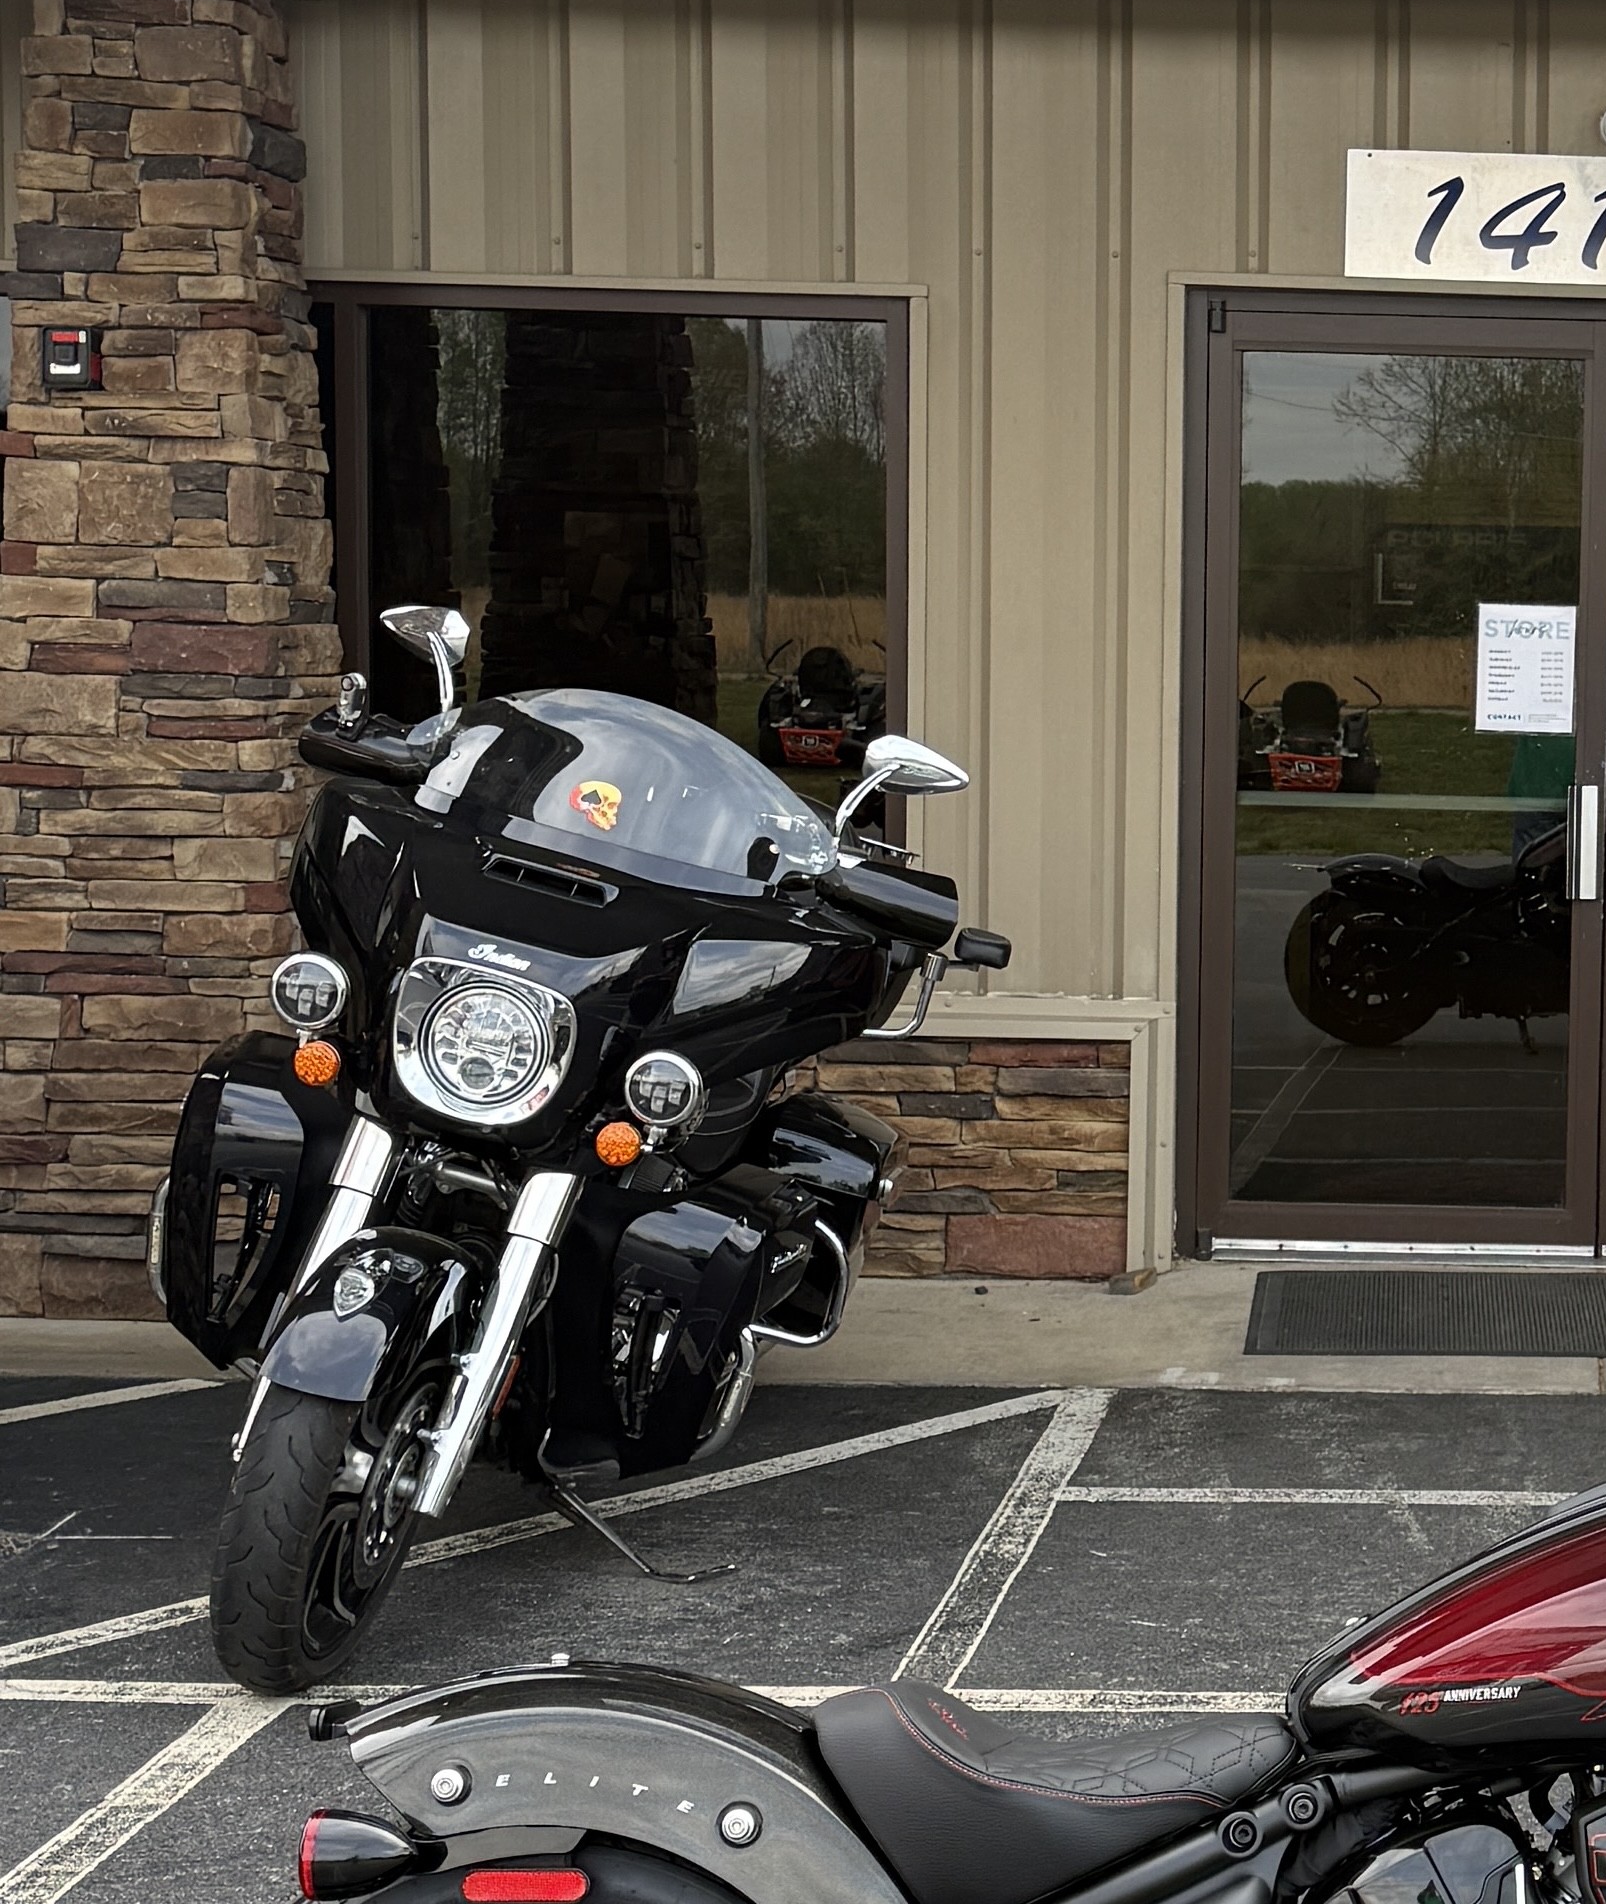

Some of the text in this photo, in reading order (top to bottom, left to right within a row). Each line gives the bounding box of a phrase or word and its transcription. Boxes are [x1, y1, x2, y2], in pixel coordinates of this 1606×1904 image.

[1484, 618, 1570, 640] STORE
[1443, 1686, 1521, 1702] ANNIVERSARY
[495, 1771, 695, 1814] ELITE
